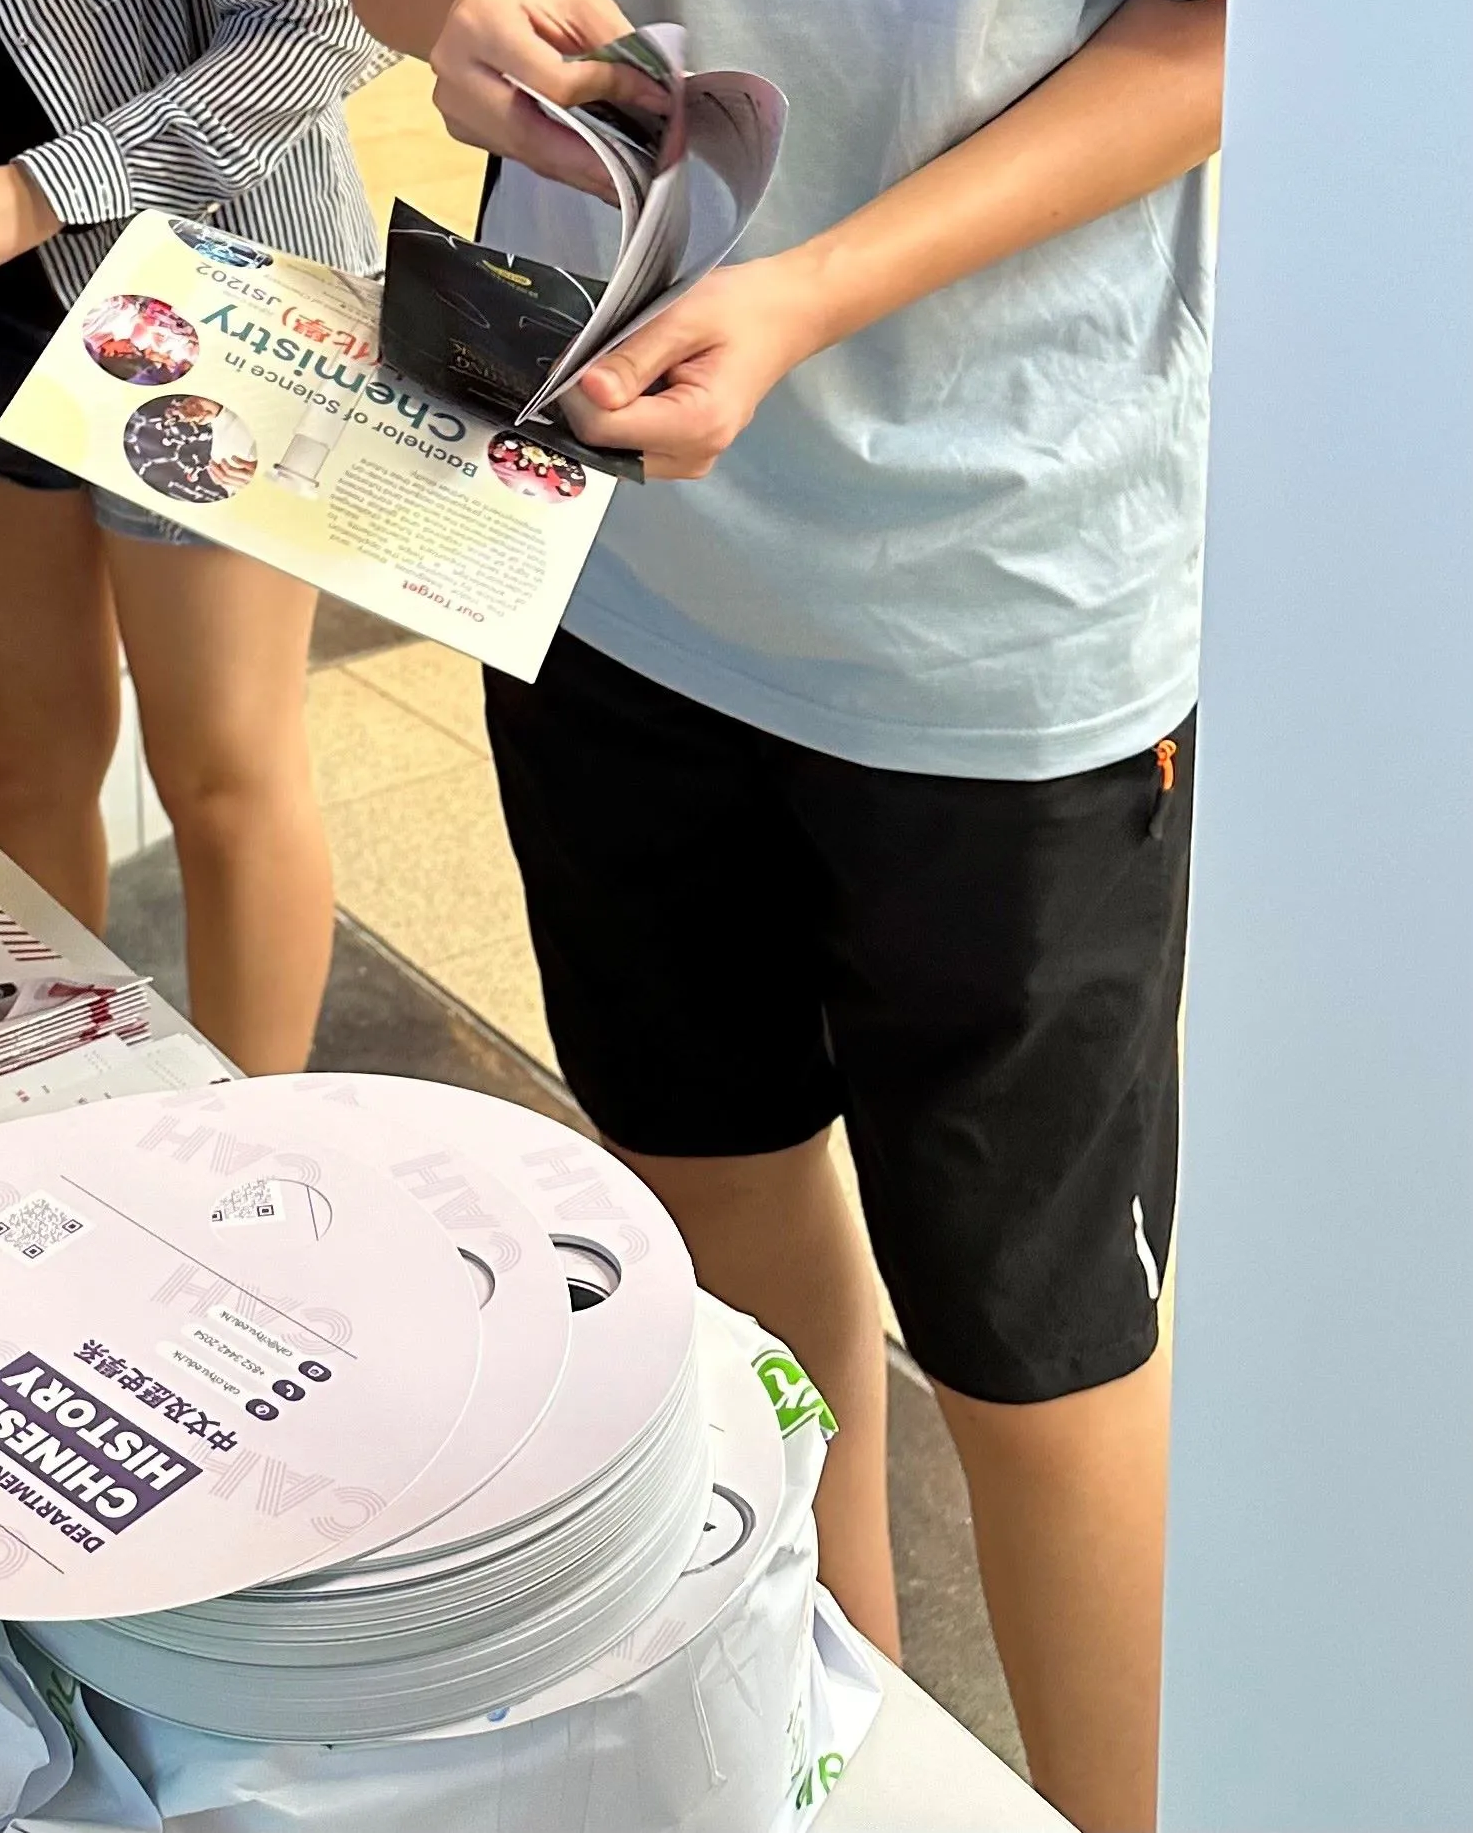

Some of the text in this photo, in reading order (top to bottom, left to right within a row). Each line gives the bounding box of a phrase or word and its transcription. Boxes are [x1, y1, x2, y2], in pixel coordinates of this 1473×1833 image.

[195, 261, 282, 306] JS1202
[199, 304, 468, 445] Chemistry
[224, 351, 478, 478] Bachelor of Science in
[401, 578, 485, 624] Our Target
[390, 1150, 523, 1274] CAH
[1, 1366, 188, 1491] HISTORY
[73, 1339, 239, 1453] 中文及歷史學系
